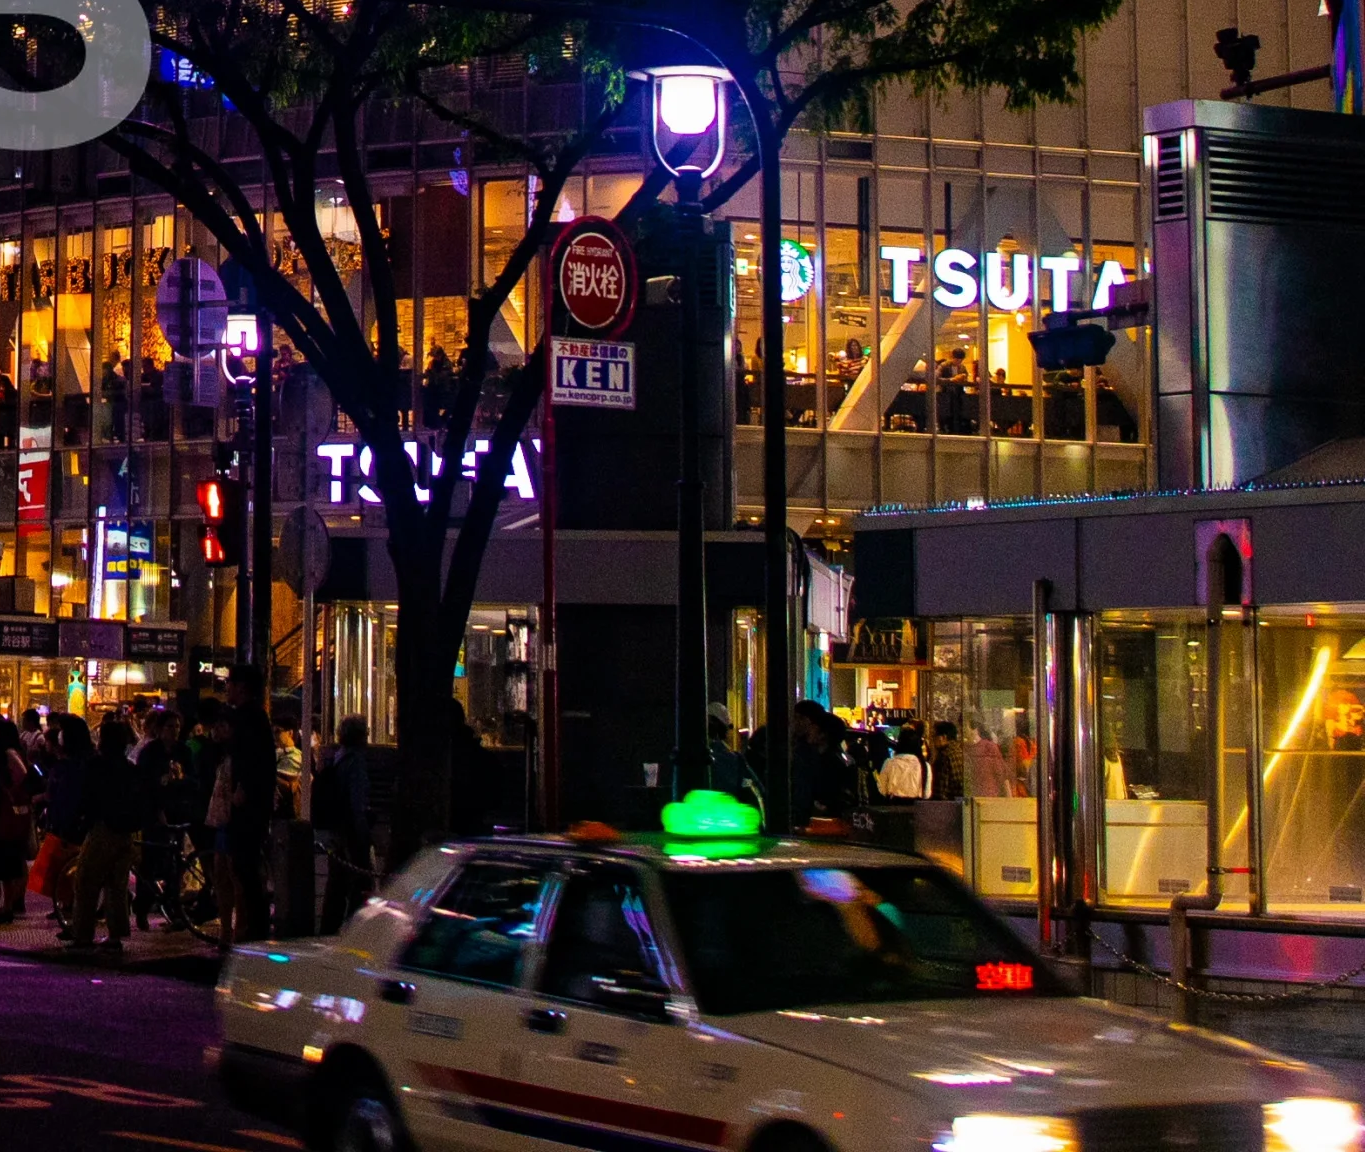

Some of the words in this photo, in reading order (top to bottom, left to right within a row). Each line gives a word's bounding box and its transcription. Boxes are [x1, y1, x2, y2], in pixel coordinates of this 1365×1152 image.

[571, 245, 586, 256] FIRE
[568, 260, 619, 299] 消火栓
[561, 359, 625, 390] KEN
[975, 962, 1034, 990] 空車
